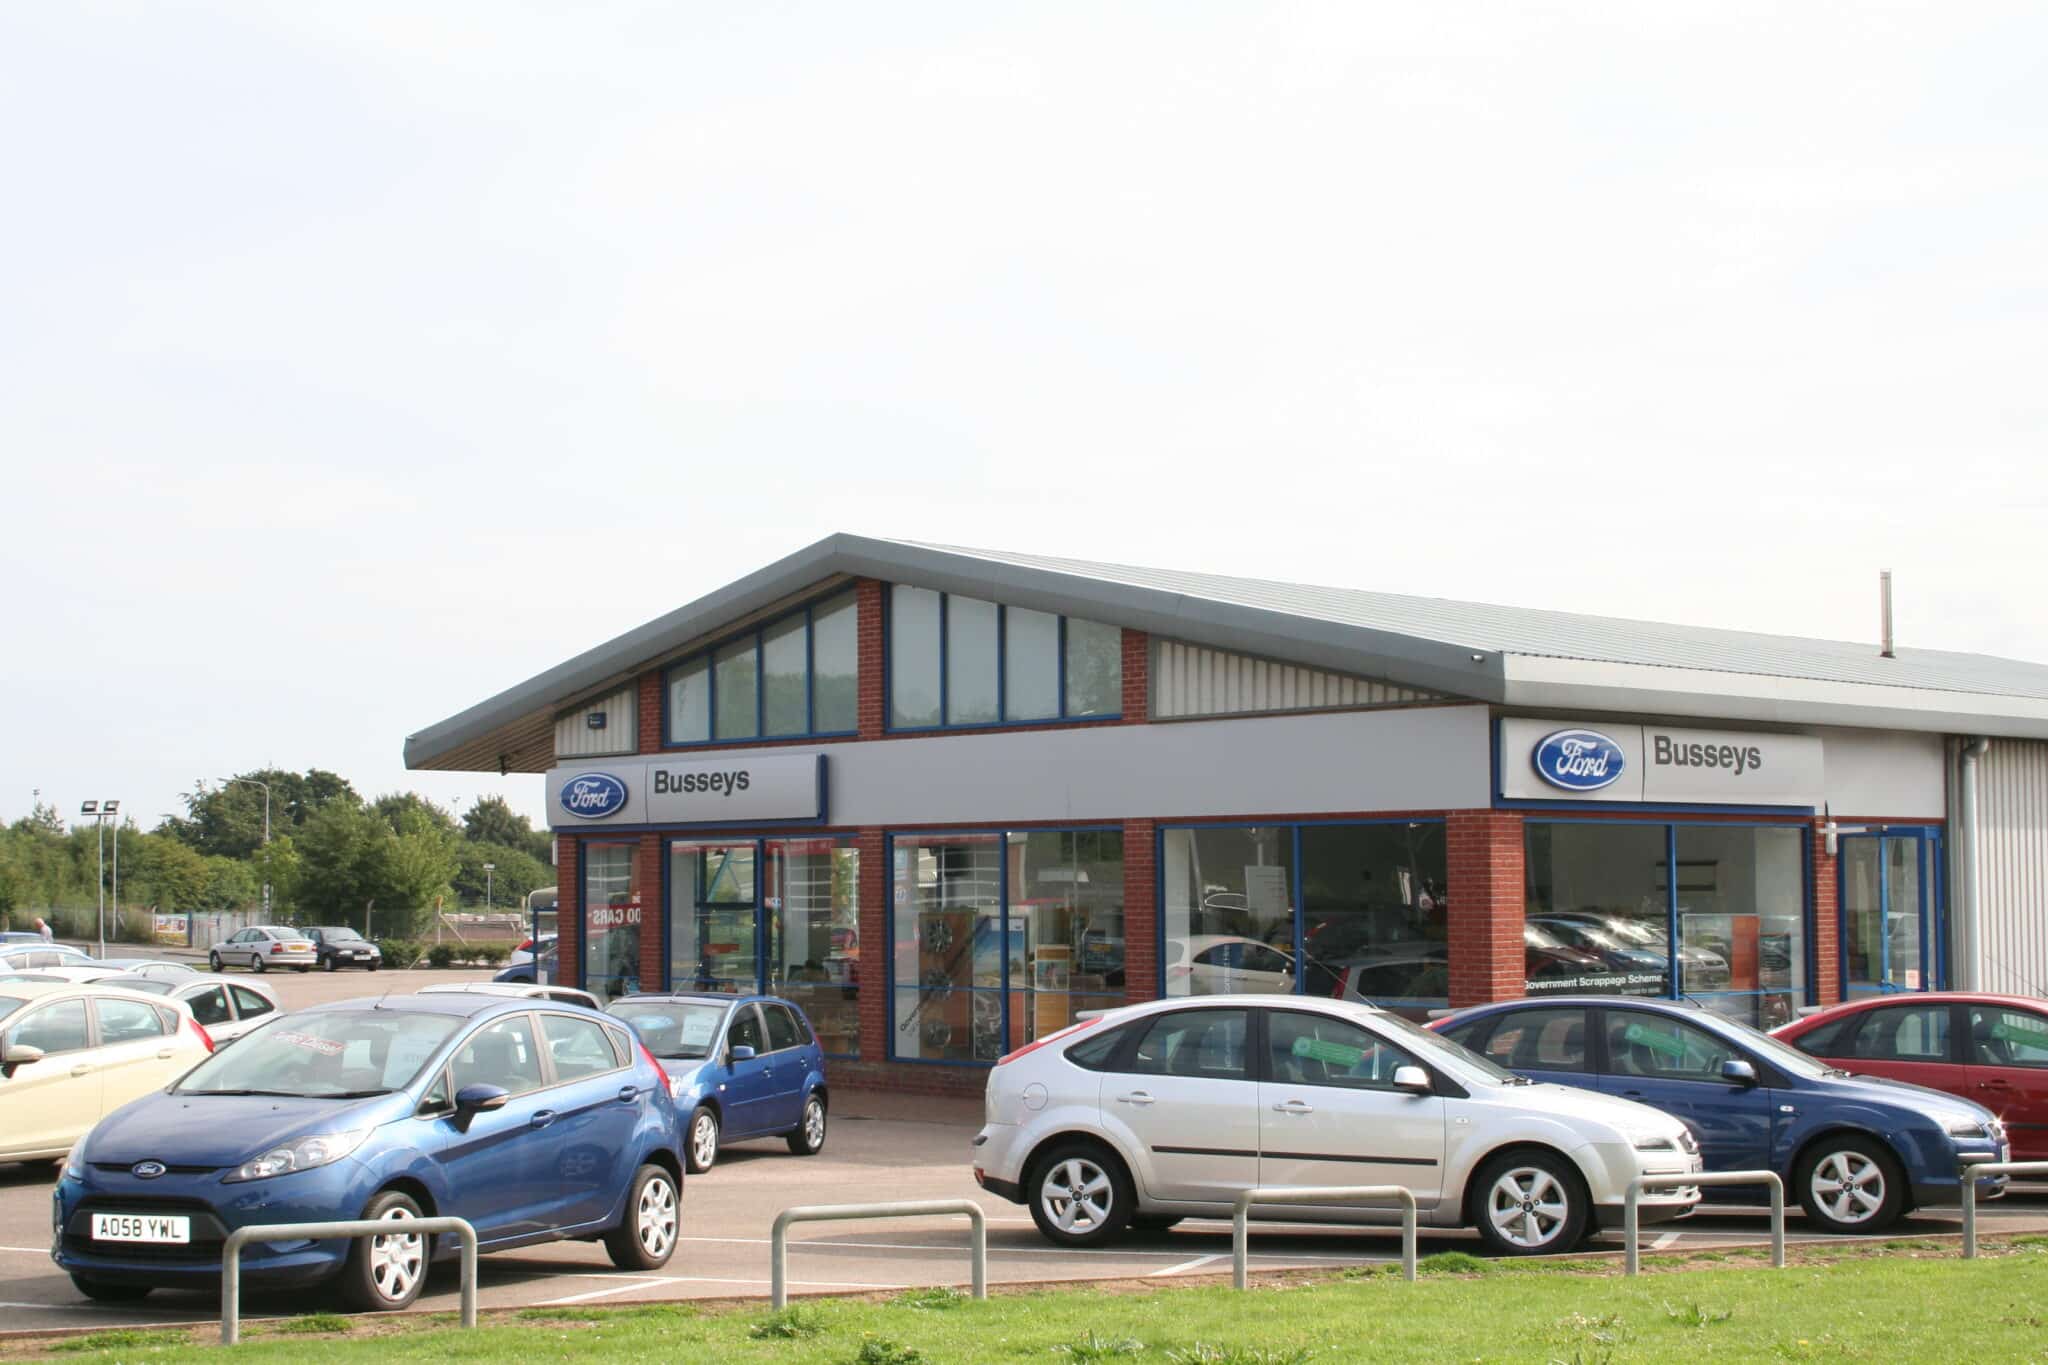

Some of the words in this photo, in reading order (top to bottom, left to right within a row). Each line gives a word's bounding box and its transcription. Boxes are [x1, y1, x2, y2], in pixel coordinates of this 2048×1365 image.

[1555, 738, 1609, 777] Ford
[1654, 735, 1761, 776] Busseys
[569, 780, 609, 808] Ford
[654, 769, 750, 797] Busseys
[1579, 975, 1626, 988] Scrappage
[1628, 973, 1662, 984] Scheme
[148, 1219, 181, 1238] YWL
